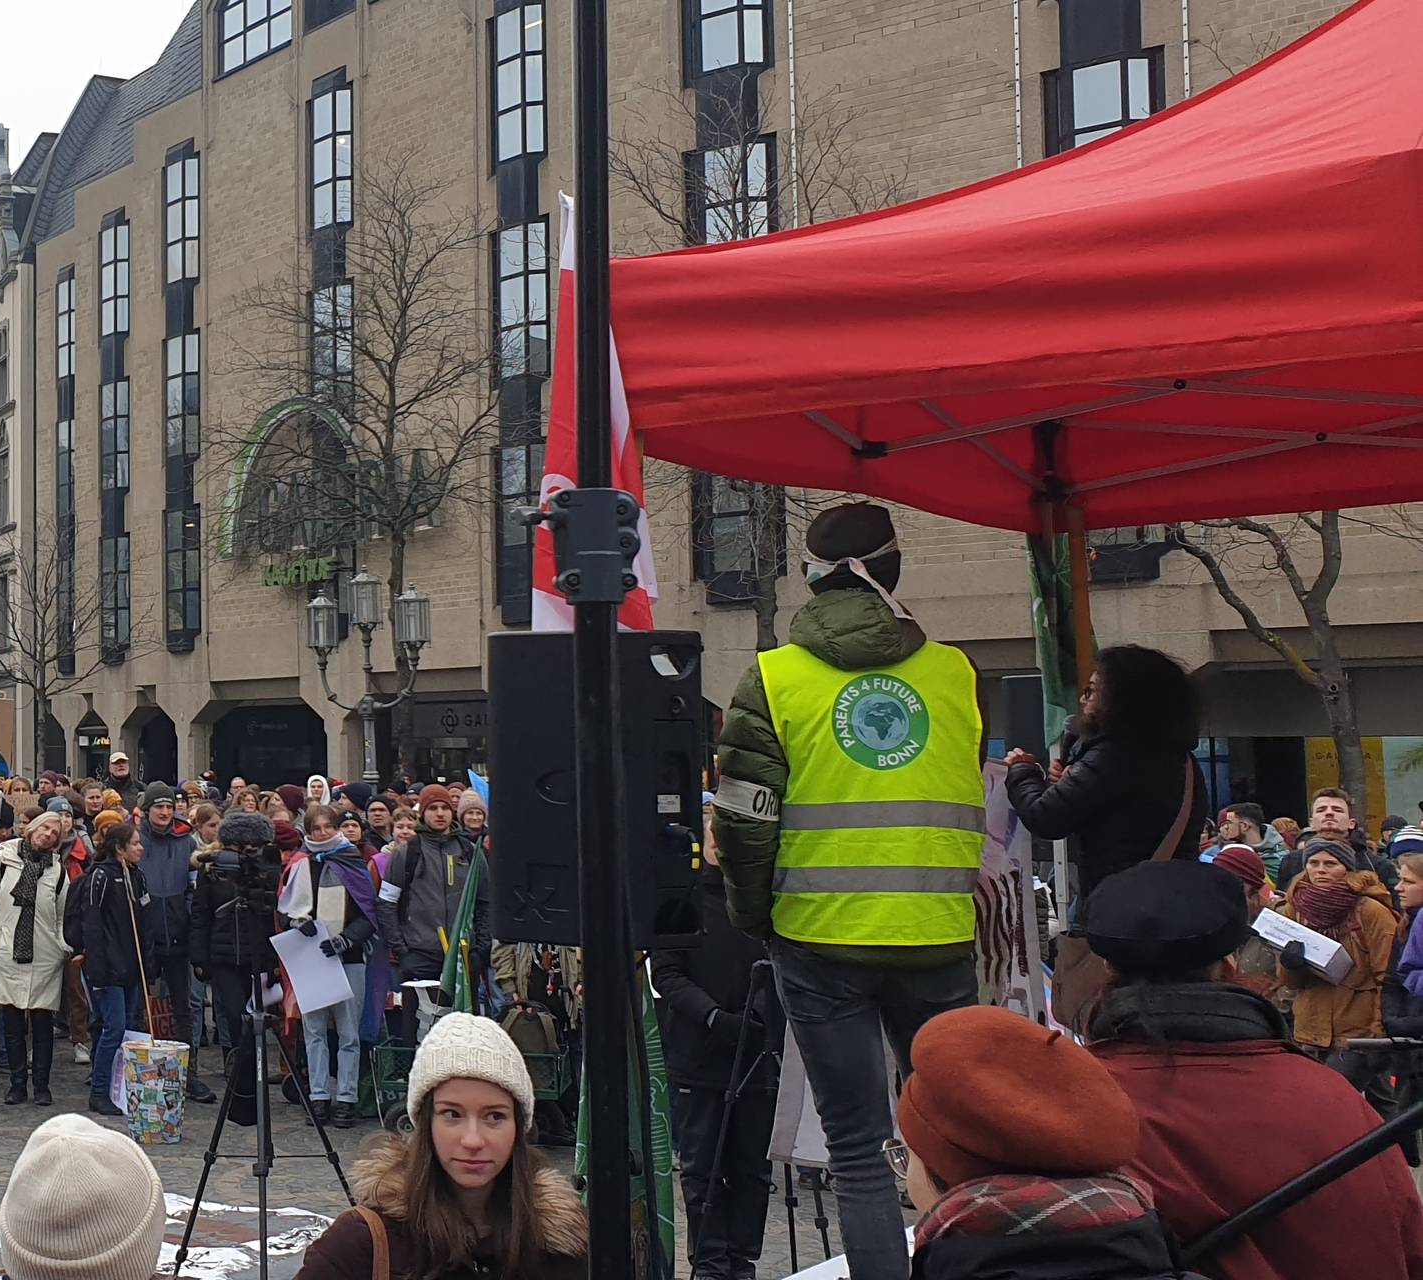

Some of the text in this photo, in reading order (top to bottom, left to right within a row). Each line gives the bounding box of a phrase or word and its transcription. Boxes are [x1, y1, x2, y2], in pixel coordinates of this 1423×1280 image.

[836, 678, 922, 748] PARENTS 4 FUTURE
[878, 739, 920, 767] BONN
